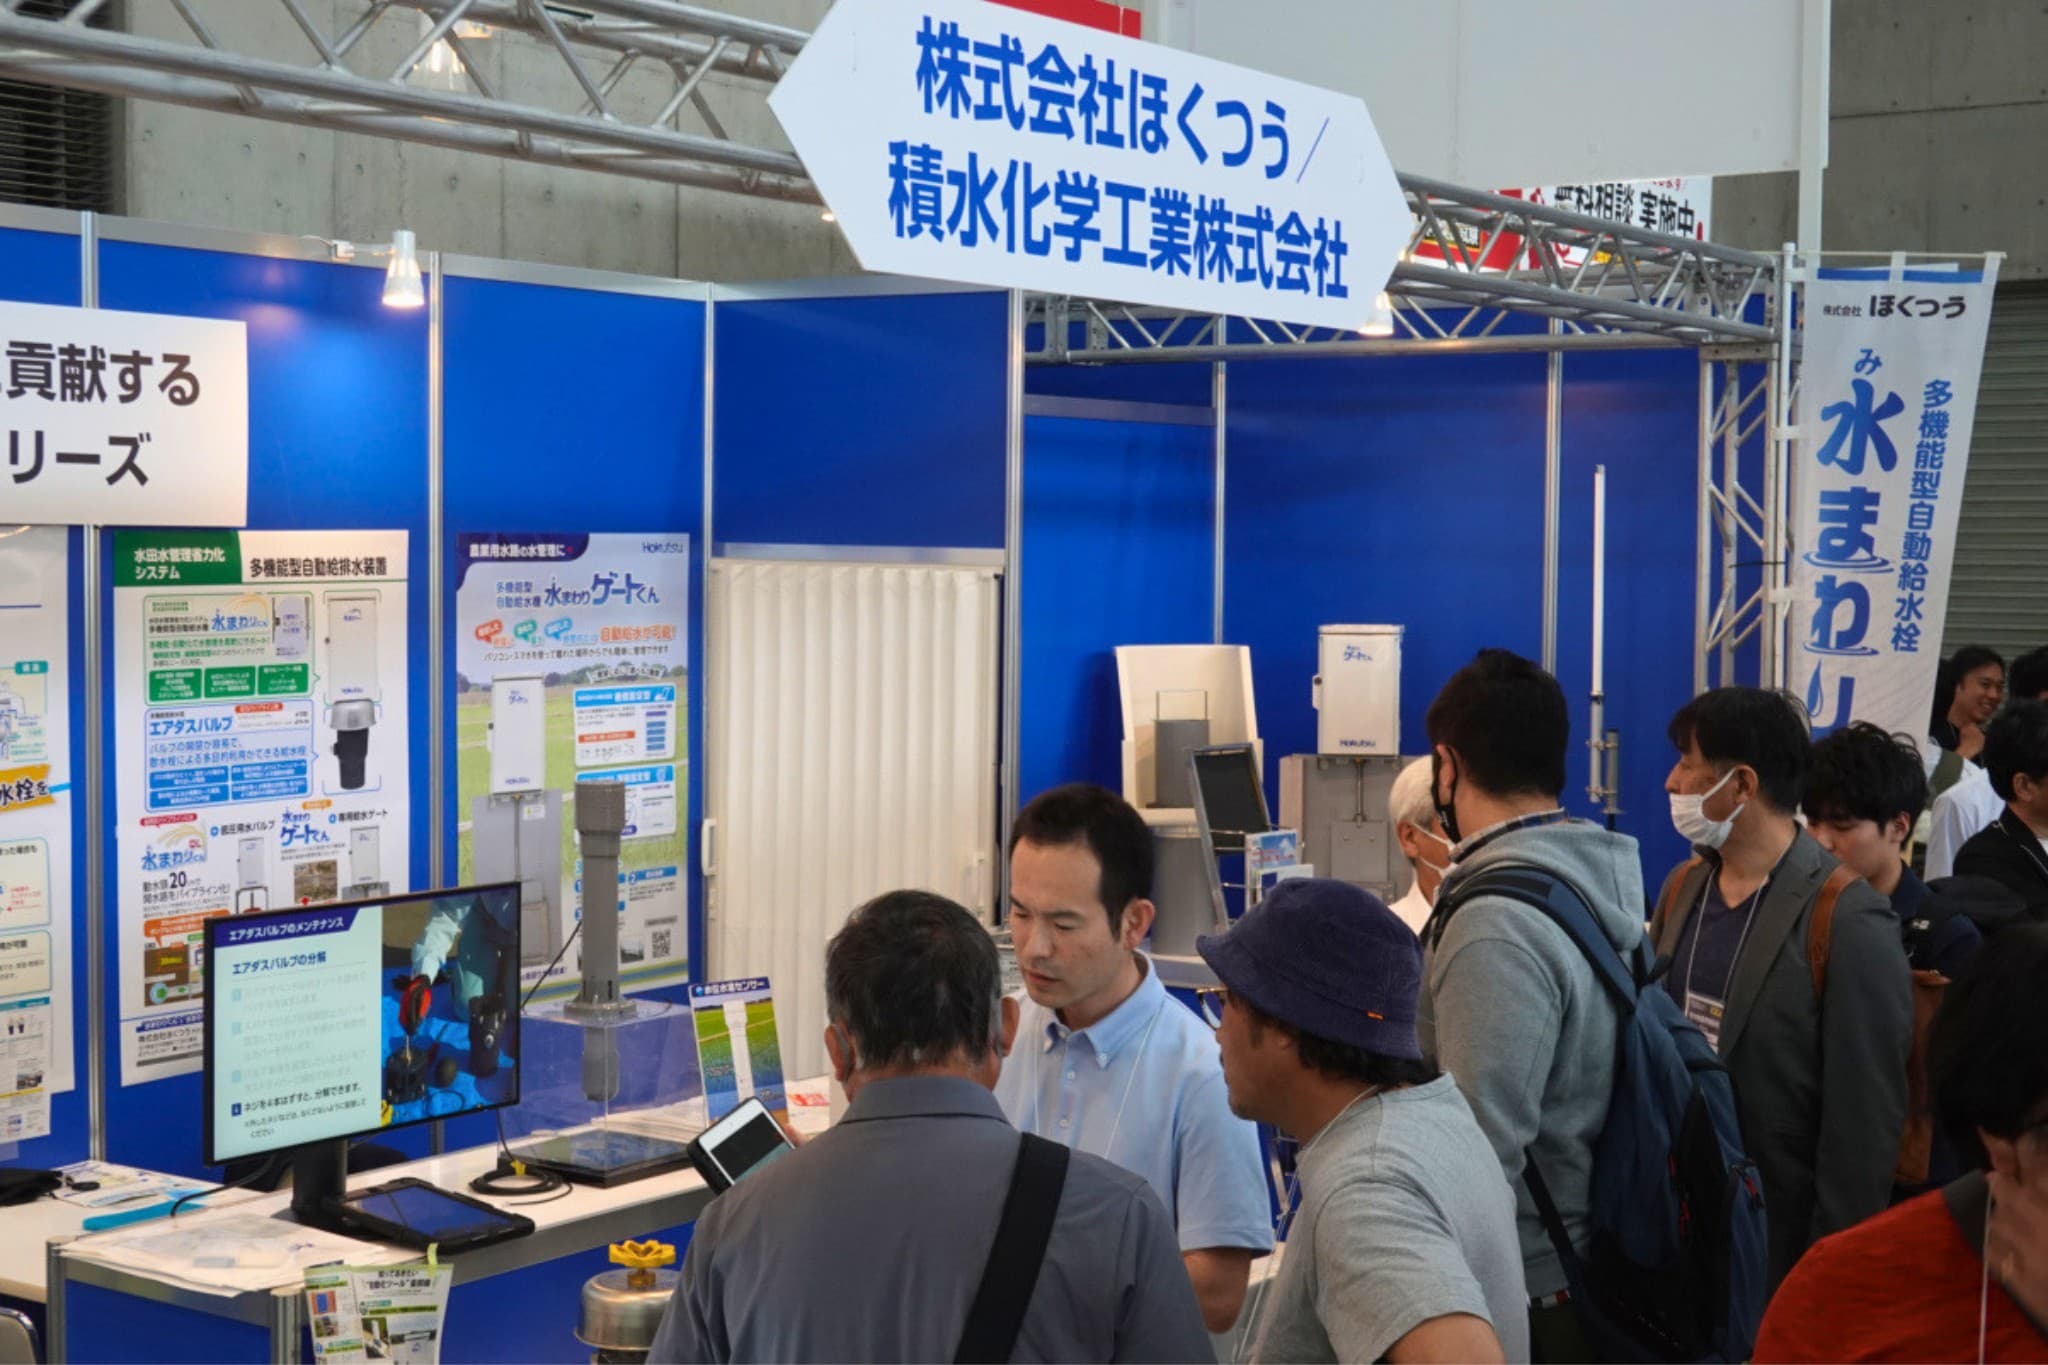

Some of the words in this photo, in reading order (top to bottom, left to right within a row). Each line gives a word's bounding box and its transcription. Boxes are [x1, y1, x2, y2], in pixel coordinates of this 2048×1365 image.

[888, 140, 1349, 299] 積水化学工業株式会社
[1639, 189, 1696, 238] 実施中
[1822, 304, 1862, 317] 株式会社
[1869, 295, 1966, 319] ほくつう
[0, 341, 200, 406] 貢献する
[1853, 348, 1882, 376] み
[8, 430, 152, 486] リーズ
[1891, 379, 1953, 653] 多機能型自動給水栓
[135, 566, 180, 580] システム
[250, 556, 387, 578] 多機能型自動給排水装置
[150, 716, 233, 736] エアダスバルブ
[228, 916, 345, 942] エアダスバルブのメンテナンス
[232, 951, 327, 976] エアダスバルブの分解
